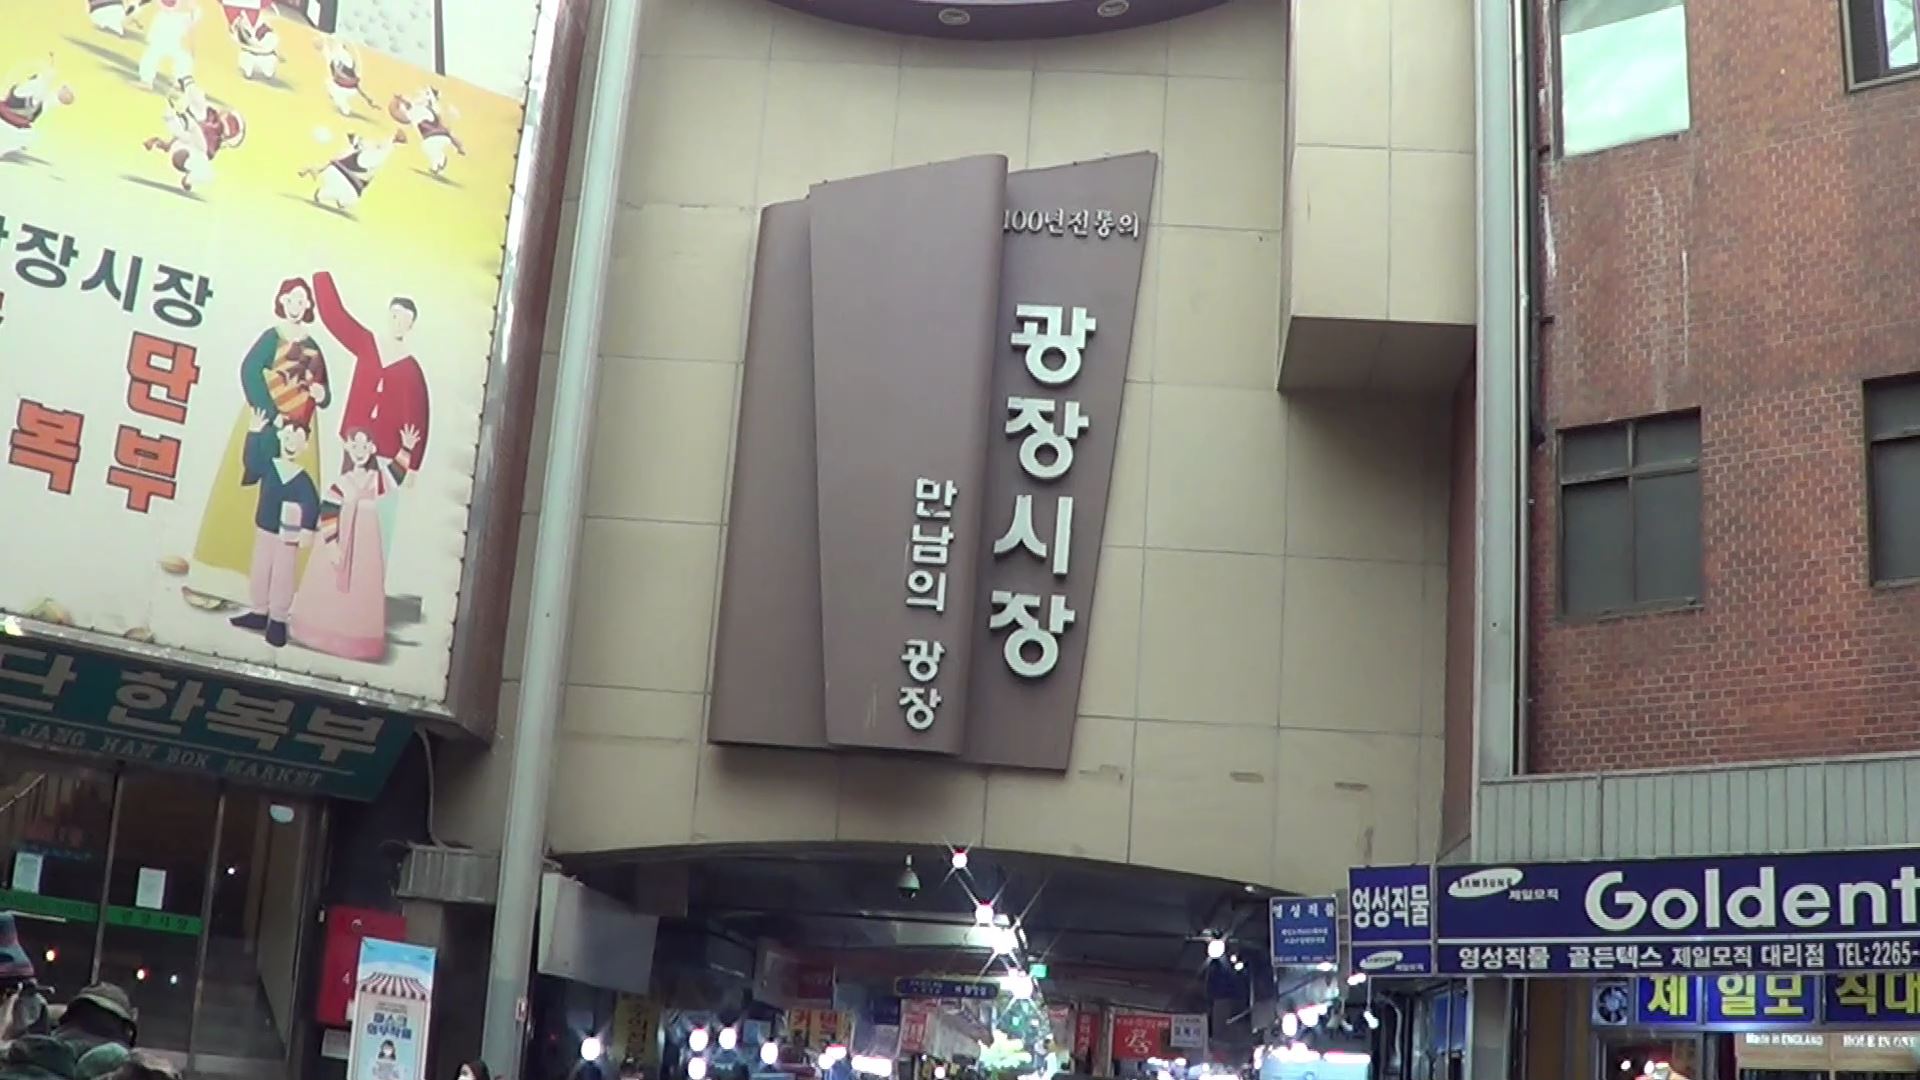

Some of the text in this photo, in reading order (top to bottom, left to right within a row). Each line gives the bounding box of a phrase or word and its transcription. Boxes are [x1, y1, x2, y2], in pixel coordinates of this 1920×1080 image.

[0, 215, 213, 328] 장시장
[990, 304, 1096, 677] 광장시장
[899, 477, 958, 730] 만남의 광장
[107, 670, 385, 763] 한복부
[20, 722, 87, 746] JANG
[226, 757, 322, 787] MARKET
[1353, 884, 1430, 928] 영성직물
[1457, 876, 1514, 889] SAMSUNG
[1507, 888, 1560, 901] 제일모직
[1459, 946, 1550, 970] 영성직물
[1567, 945, 1664, 969] 골든텍스
[1671, 944, 1753, 968] 제일모직
[1760, 942, 1825, 968] 대리점
